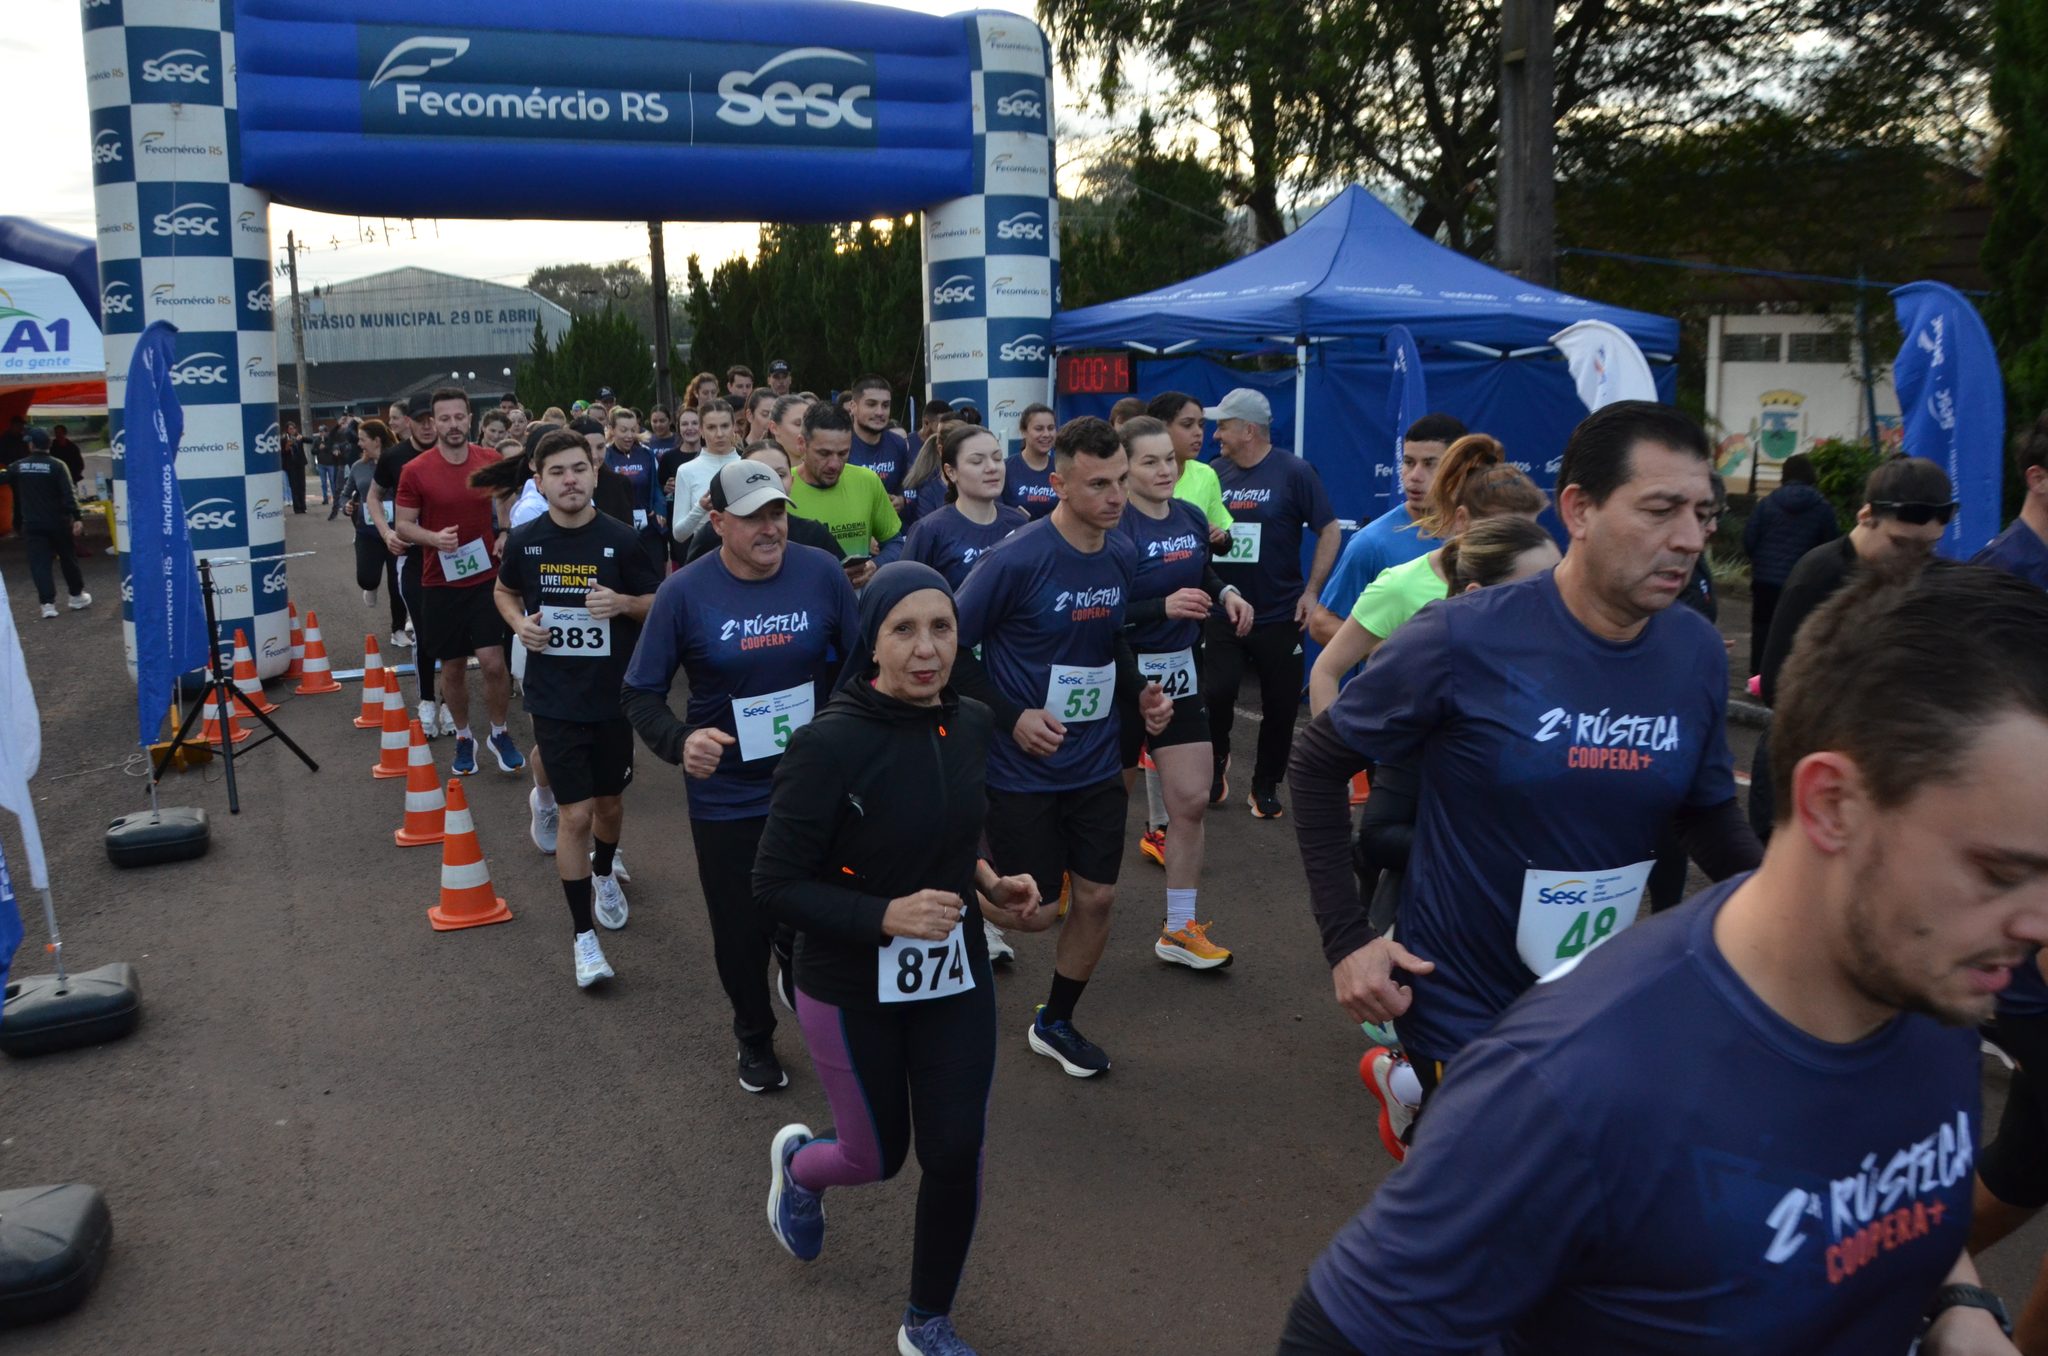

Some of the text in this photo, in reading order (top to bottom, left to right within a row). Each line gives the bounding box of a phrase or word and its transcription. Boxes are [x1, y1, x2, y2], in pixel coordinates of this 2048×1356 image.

[142, 59, 210, 84] Sesc
[396, 83, 669, 124] Fecomércio RS
[716, 69, 873, 130] Sesc
[997, 96, 1042, 119] Sesc
[145, 143, 223, 156] Fecomércio RS
[153, 214, 219, 236] Sesc
[997, 220, 1043, 240] Sesc
[155, 294, 231, 306] Fecomércio RS
[933, 285, 976, 305] Sesc
[360, 312, 446, 329] MUNICIPAL
[450, 310, 470, 325] 29
[475, 309, 494, 324] DE
[1, 318, 70, 353] A1
[1000, 342, 1046, 362] Sesc
[28, 355, 71, 371] gente
[226, 442, 240, 450] RS
[162, 464, 172, 536] Sindicatos
[524, 546, 542, 555] LIVE!
[454, 554, 479, 576] 54
[540, 563, 598, 575] FINISHER
[236, 584, 248, 593] RS
[743, 611, 809, 637] RÚSTICA
[548, 626, 604, 649] 883
[741, 632, 794, 651] COOPERA+
[1058, 675, 1084, 685] Sesc
[743, 705, 772, 718] Sesc
[1064, 687, 1101, 718] 53
[1575, 707, 1680, 751] RÚSTICA
[1567, 746, 1655, 770] COOPERA+
[1538, 887, 1588, 905] Sesc
[896, 940, 964, 994] 874
[1829, 1110, 1973, 1243] RÚSTICA
